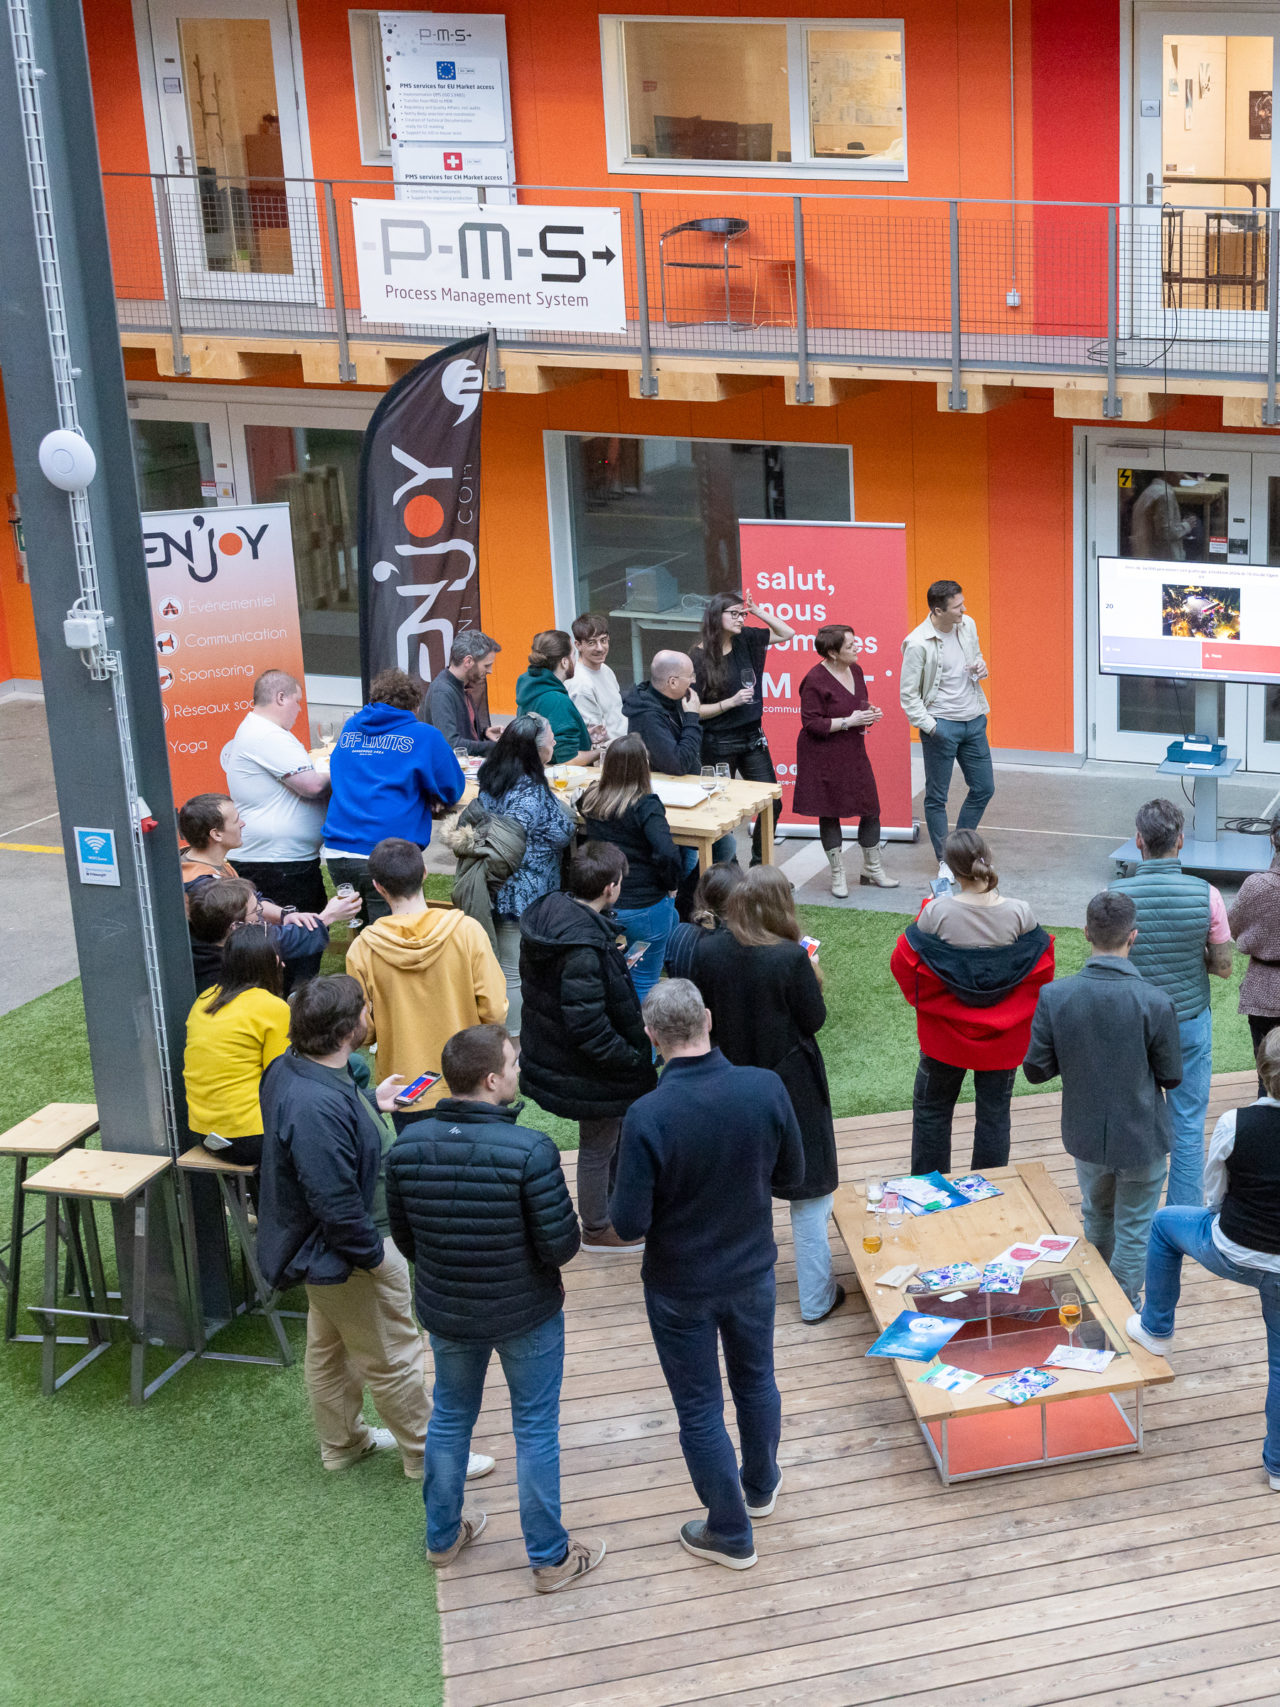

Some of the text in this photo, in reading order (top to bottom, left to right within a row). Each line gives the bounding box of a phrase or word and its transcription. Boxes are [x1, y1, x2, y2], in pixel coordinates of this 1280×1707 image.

[385, 285, 589, 308] Process Management System
[756, 565, 835, 596] salut,
[758, 602, 827, 622] nous
[184, 628, 287, 648] Communication
[179, 664, 255, 683] Sponsoring
[173, 703, 231, 719] Réseaux
[169, 740, 208, 754] Yoga
[340, 731, 414, 753] OFF LIMITS
